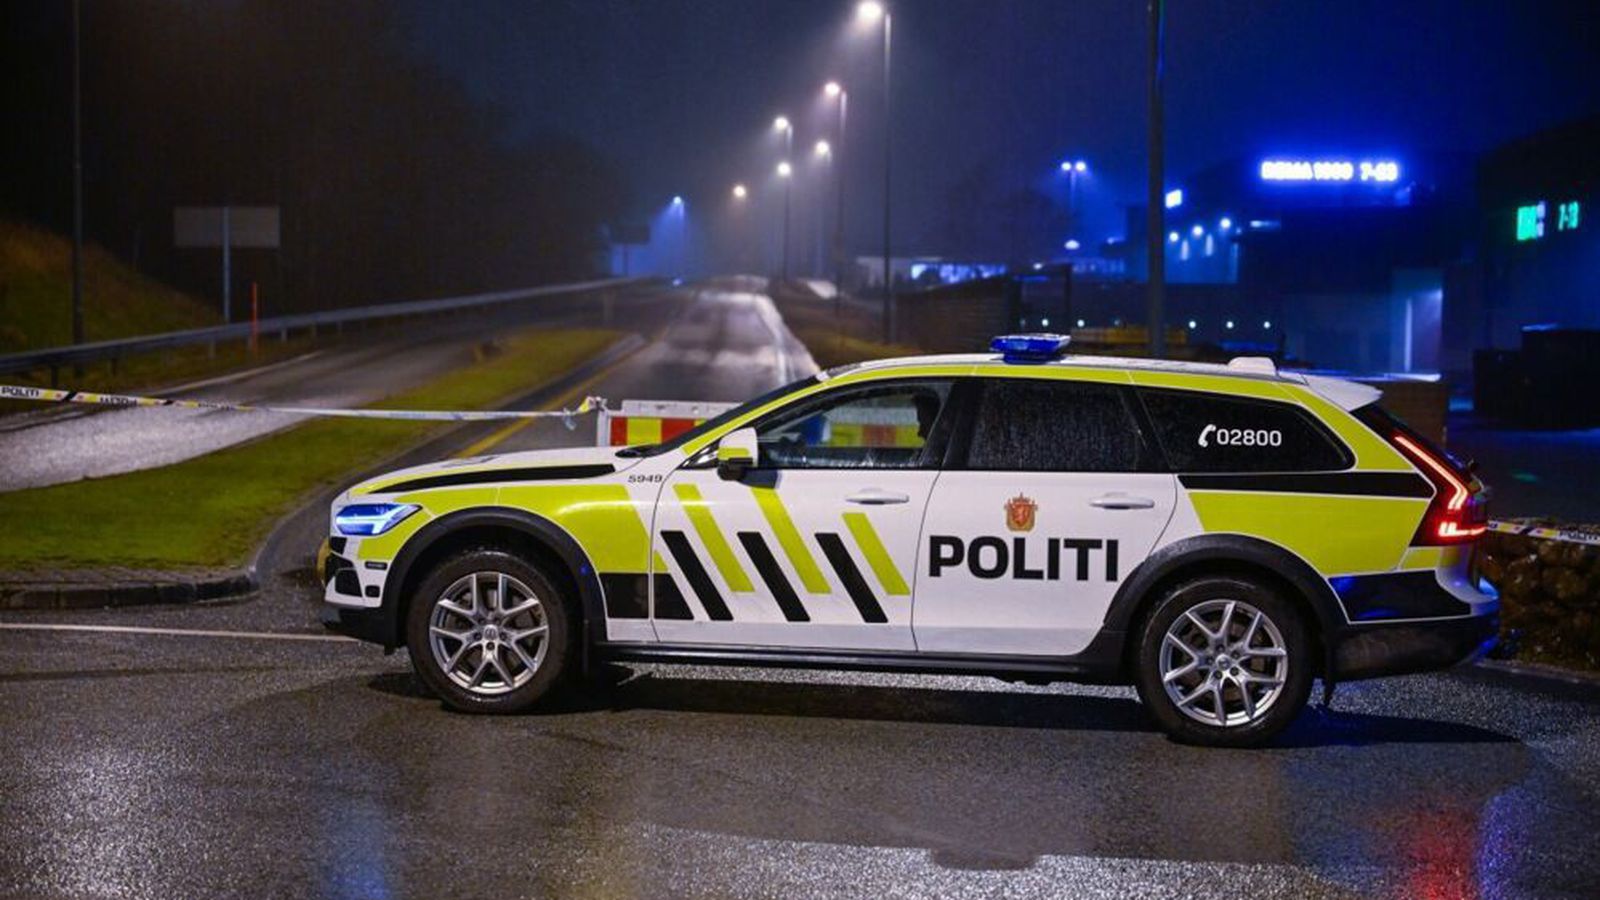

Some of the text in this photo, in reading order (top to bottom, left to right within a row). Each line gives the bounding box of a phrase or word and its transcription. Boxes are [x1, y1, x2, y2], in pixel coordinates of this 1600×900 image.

[1, 386, 40, 398] POLITI
[1217, 428, 1282, 446] 02800
[628, 473, 663, 484] 5949
[928, 535, 1119, 582] POLITI
